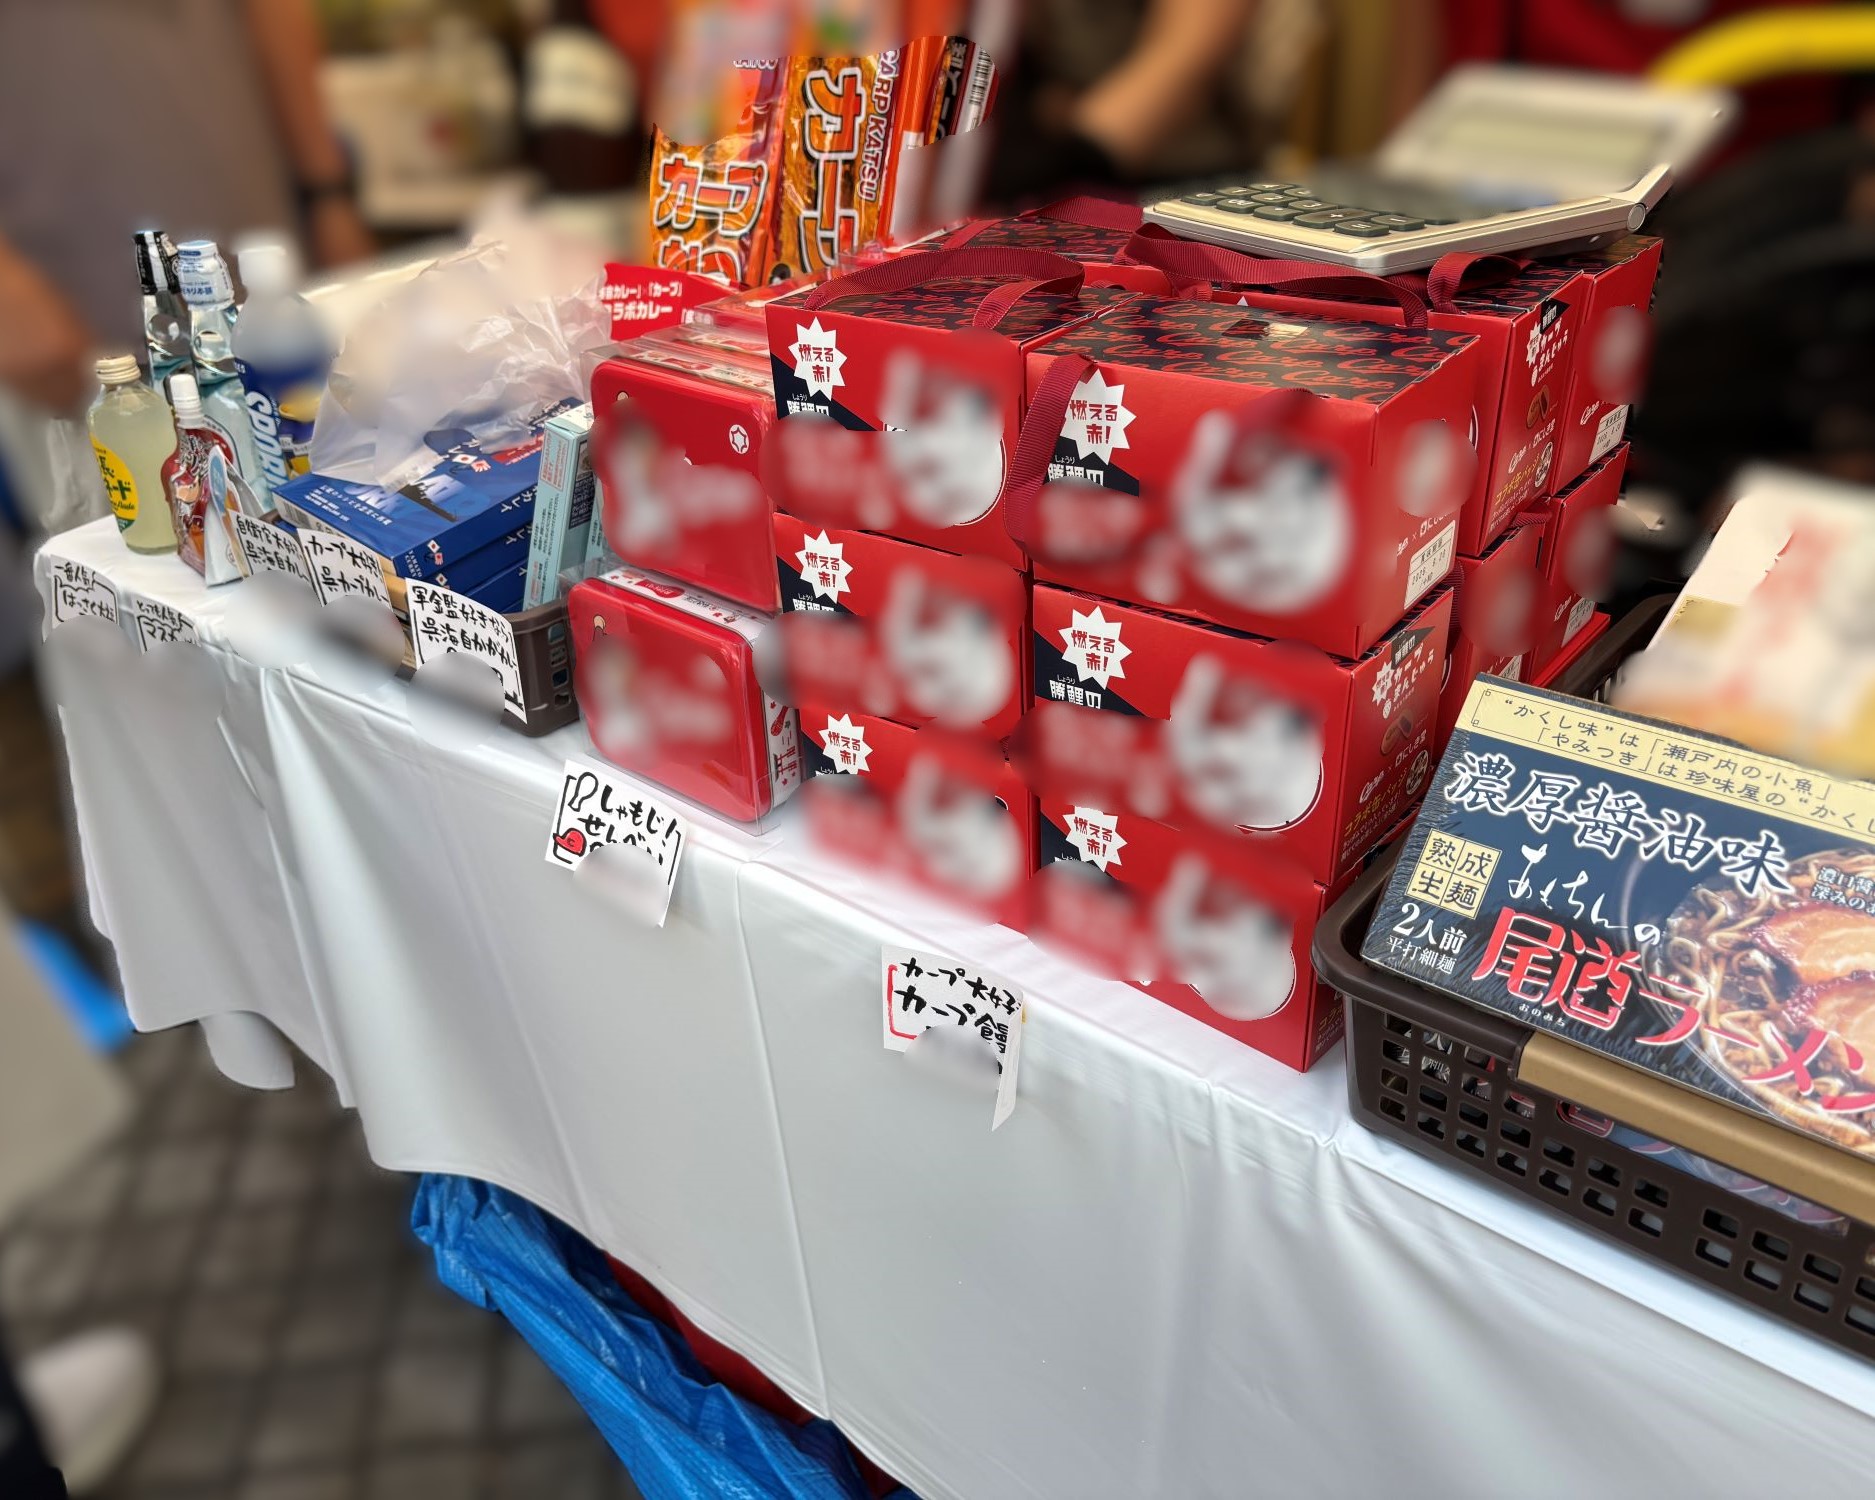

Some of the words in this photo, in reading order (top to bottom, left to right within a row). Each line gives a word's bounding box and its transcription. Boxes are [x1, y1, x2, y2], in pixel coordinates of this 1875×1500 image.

[858, 114, 887, 201] KATSU
[654, 153, 768, 237] カープ
[798, 344, 834, 362] 燃える
[1069, 399, 1118, 421] 燃える
[1086, 423, 1111, 444] 赤!
[804, 551, 840, 571] 燃える
[1070, 629, 1116, 654] 燃える
[1085, 652, 1109, 672] 赤!
[1049, 680, 1102, 710] 勝鯉の
[827, 730, 861, 752] 燃える
[1073, 816, 1113, 843] 燃える
[1425, 837, 1493, 880] 熟成
[1392, 902, 1468, 955] 2人前
[900, 957, 1022, 1015] カープ大好
[1517, 1002, 1567, 1028] おのみち
